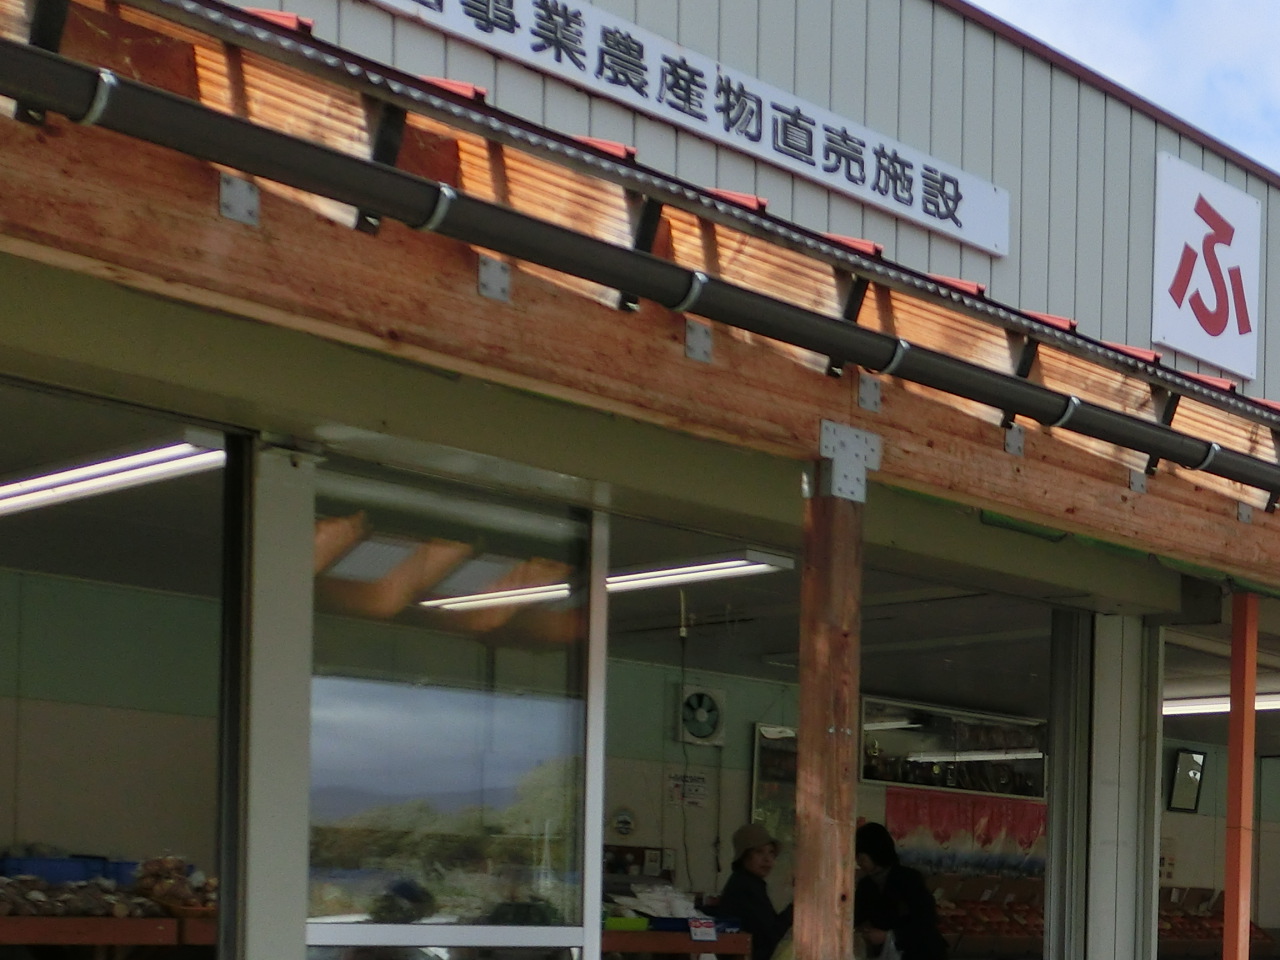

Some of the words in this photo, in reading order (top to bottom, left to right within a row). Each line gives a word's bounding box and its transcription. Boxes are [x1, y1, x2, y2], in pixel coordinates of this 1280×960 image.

[412, 0, 963, 229] 事業農産物直売施設
[1168, 193, 1252, 337] ふ
